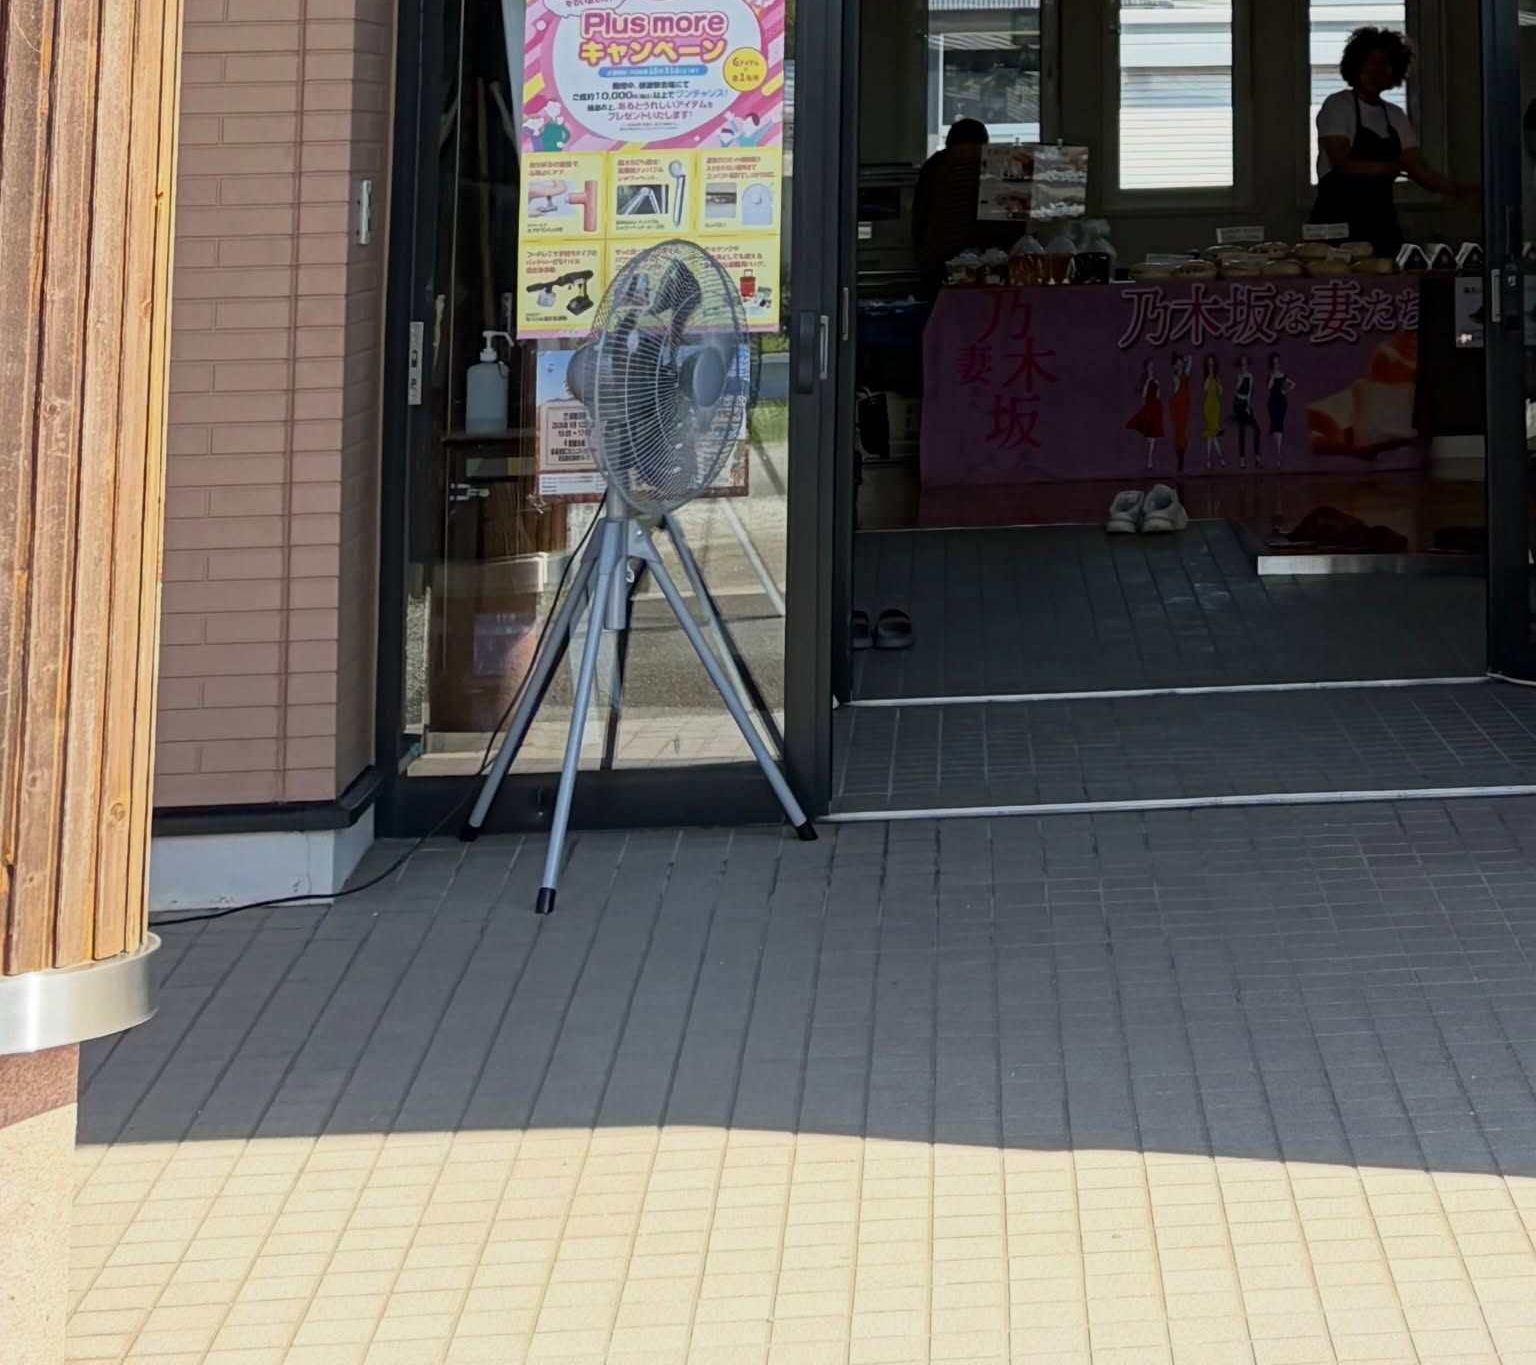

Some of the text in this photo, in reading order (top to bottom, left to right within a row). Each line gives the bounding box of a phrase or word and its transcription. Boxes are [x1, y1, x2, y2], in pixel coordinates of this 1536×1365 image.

[584, 12, 726, 35] Plus more
[580, 39, 727, 66] キャンペーン
[1118, 279, 1420, 349] 乃木坂な妻たち
